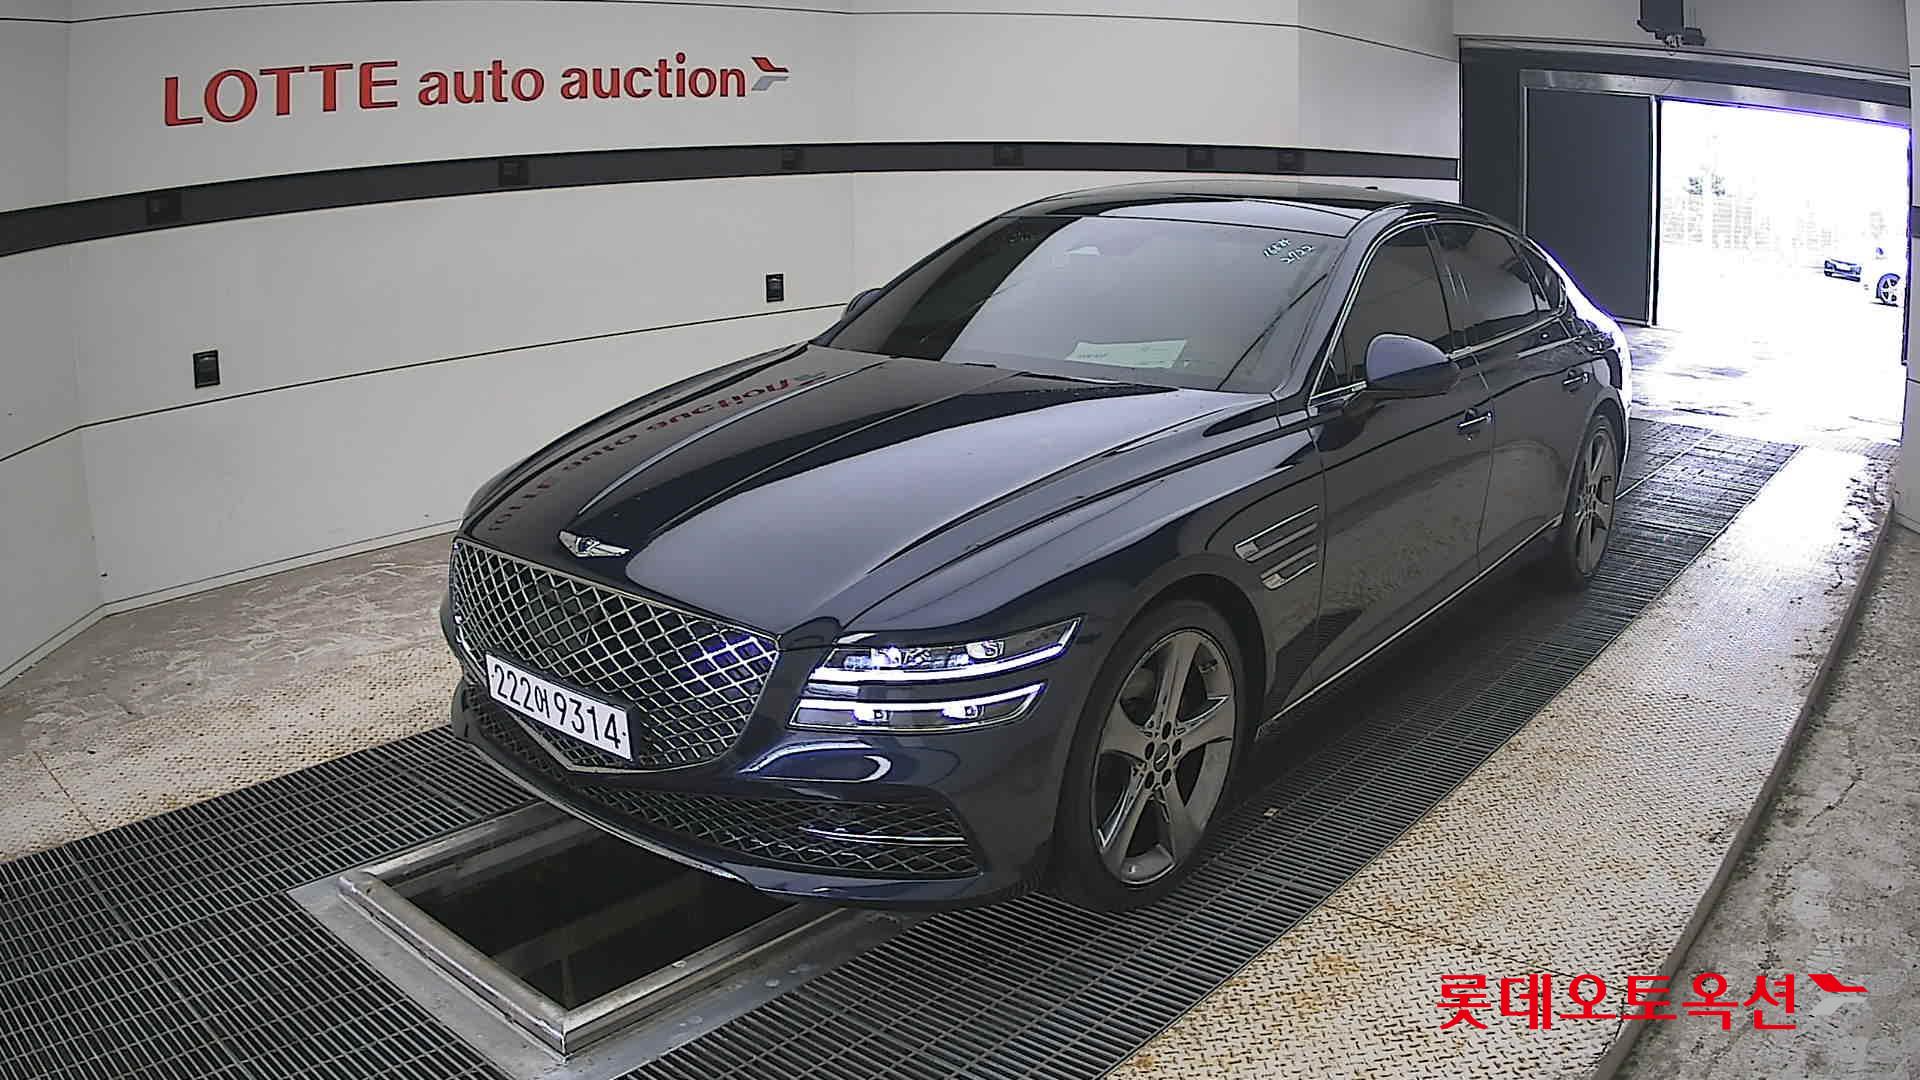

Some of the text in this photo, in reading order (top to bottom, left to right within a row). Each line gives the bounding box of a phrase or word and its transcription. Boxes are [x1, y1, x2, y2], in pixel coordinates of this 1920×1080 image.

[164, 52, 747, 127] LOTTE auto auction
